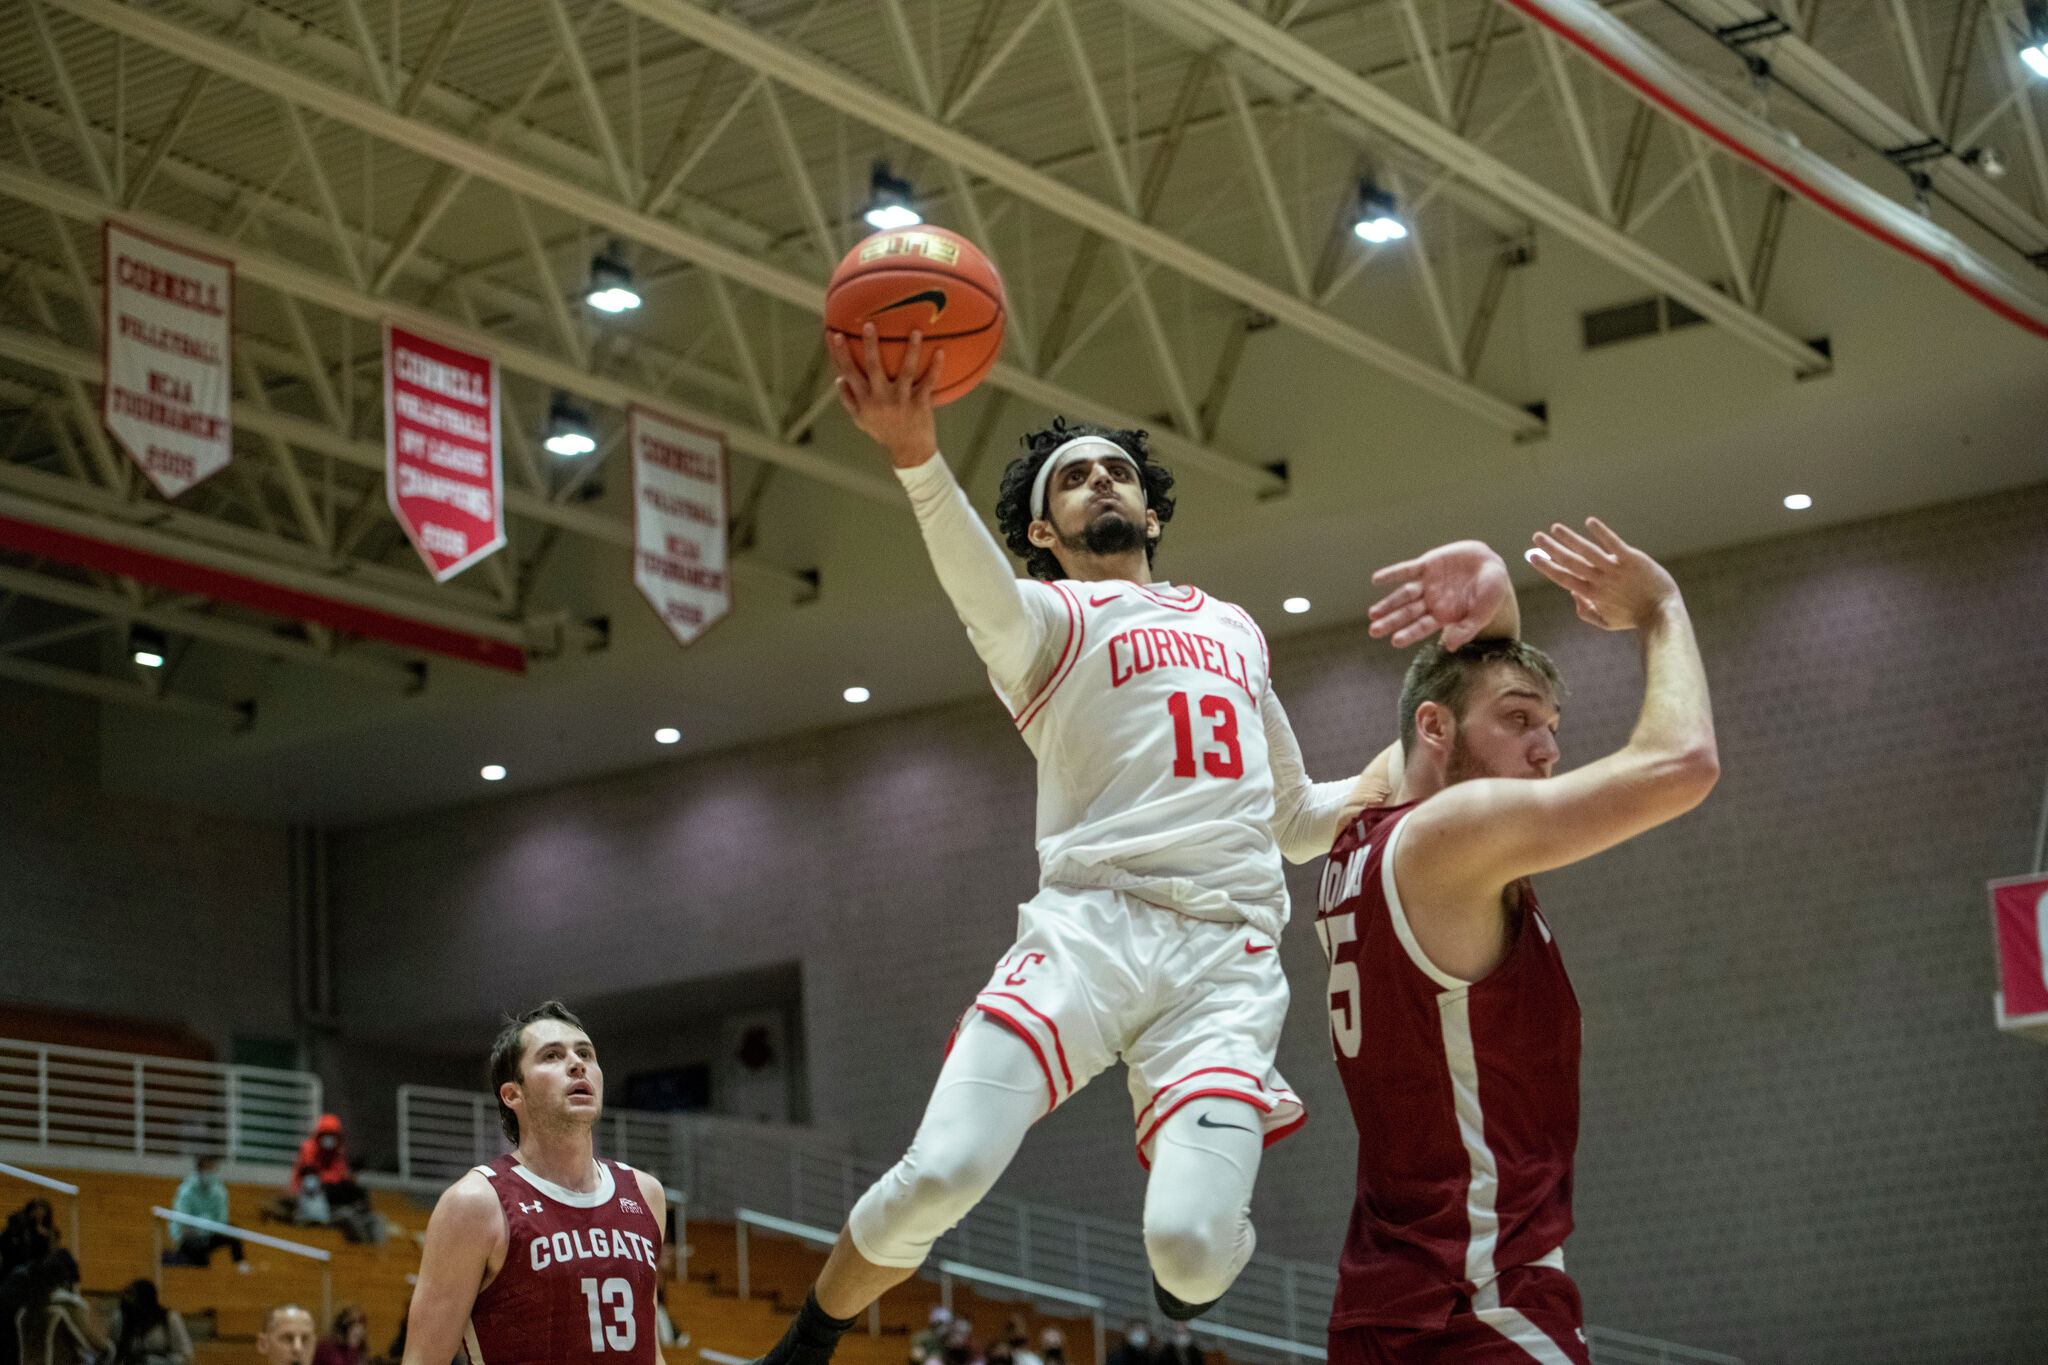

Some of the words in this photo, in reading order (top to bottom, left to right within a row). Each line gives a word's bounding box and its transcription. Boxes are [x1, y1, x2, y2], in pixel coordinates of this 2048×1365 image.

[1109, 628, 1257, 709] CORNELL
[1168, 692, 1244, 780] 13
[530, 1227, 656, 1272] COLGATE
[581, 1277, 636, 1352] 13
